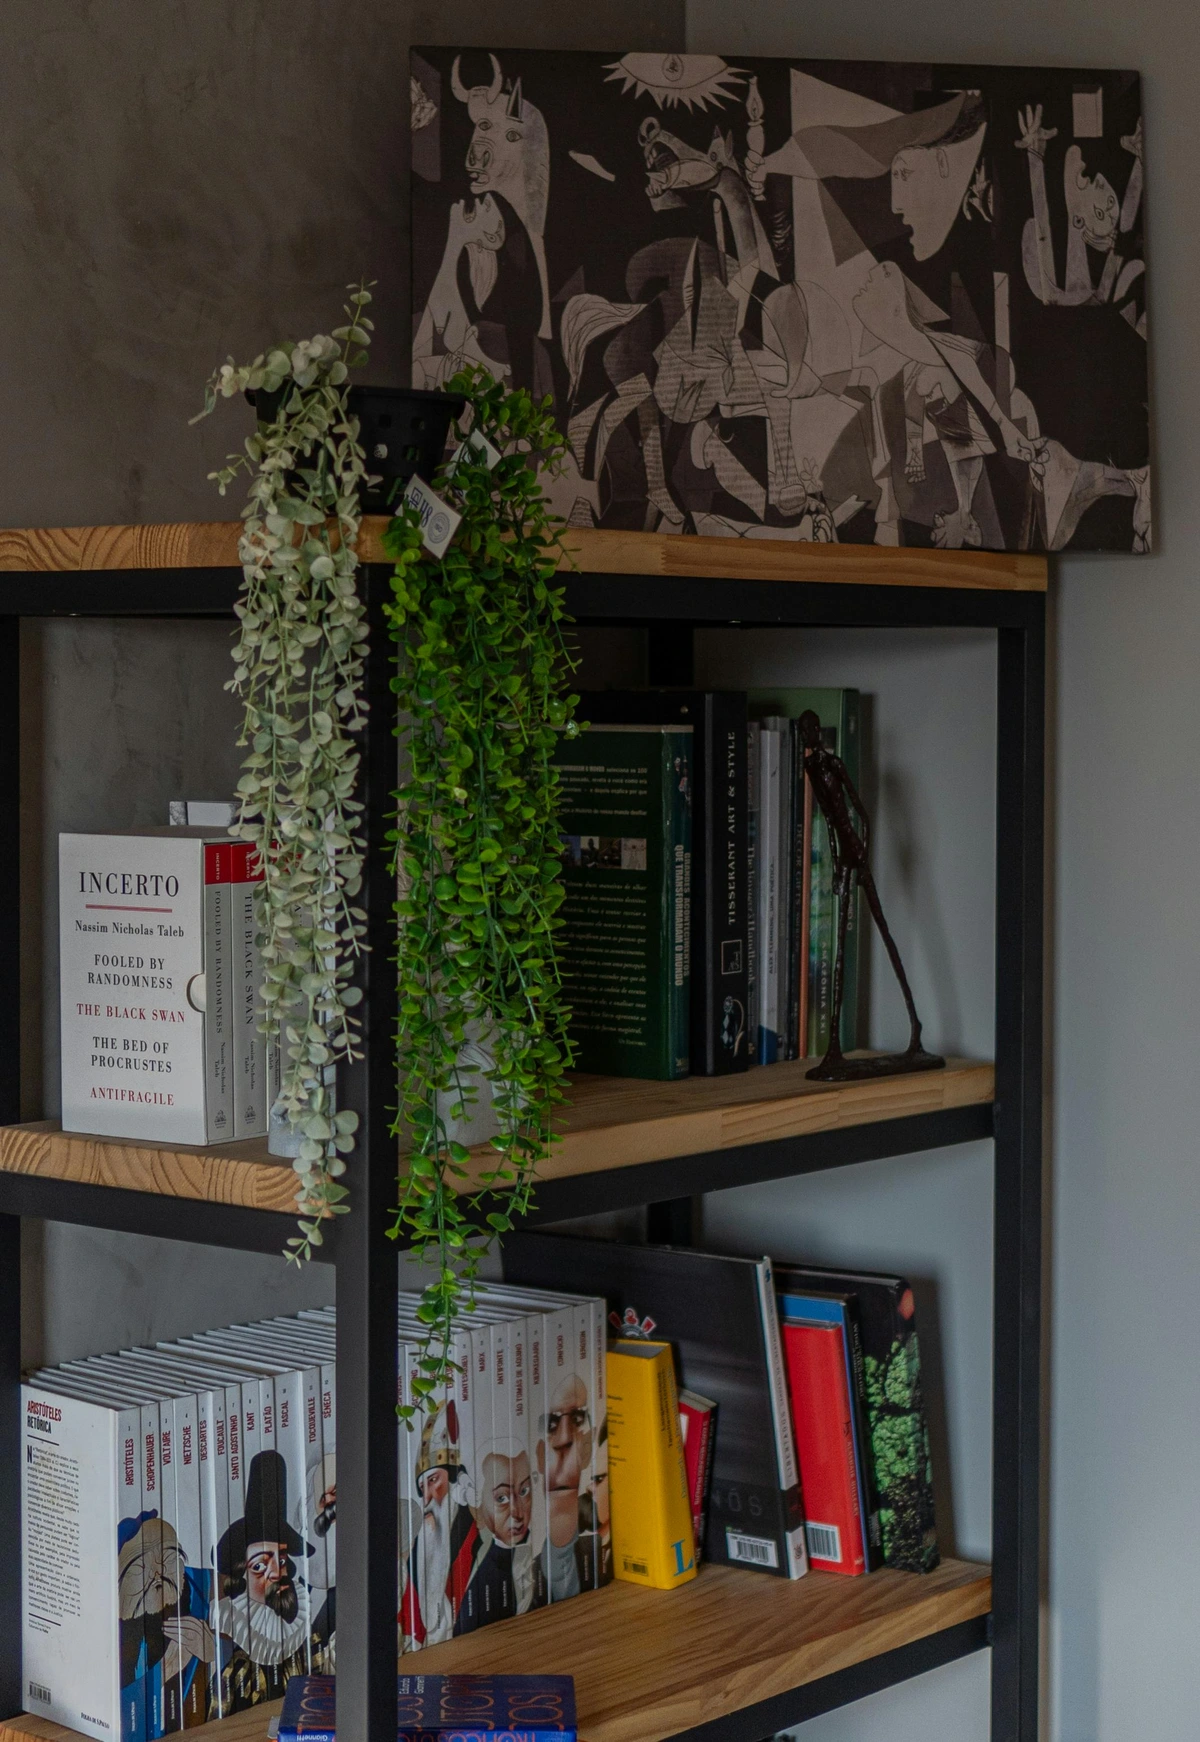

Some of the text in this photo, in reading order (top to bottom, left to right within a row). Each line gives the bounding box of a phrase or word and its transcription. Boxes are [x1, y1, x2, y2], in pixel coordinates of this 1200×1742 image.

[728, 731, 736, 926] TISSERANT ART & STYLE
[674, 844, 684, 862] QUE
[79, 871, 179, 897] INCERTO
[674, 864, 684, 943] TRANSFORMARAM
[75, 920, 185, 938] Nassim Nicholas Taleb
[215, 940, 222, 953] BY
[244, 894, 254, 1025] THE BLACK SWAN
[94, 954, 165, 970] FOOLED BY
[674, 953, 684, 986] MUNDO
[87, 972, 173, 990] RANDOMNESS
[76, 1003, 185, 1022] THE BLACK SWAN
[92, 1036, 170, 1054] THE BED OF
[91, 1054, 172, 1074] PROCRUSTES
[90, 1087, 174, 1106] ANTIFRAGILE
[515, 1368, 522, 1378] DE
[27, 1400, 62, 1422] ARISTÓTELES
[27, 1415, 52, 1434] RETÓRICA
[246, 1412, 255, 1432] KANT
[262, 1406, 272, 1434] PLATÃO
[281, 1400, 289, 1428] PASCAL
[308, 1396, 316, 1444] TOCQUEVILLE
[162, 1430, 171, 1466] VOLTAIRE
[182, 1425, 192, 1466] NIETZSCHE
[200, 1420, 208, 1461] DESCARTES
[217, 1420, 225, 1456] FOUCAULT
[230, 1414, 240, 1480] SANTO AGOSTINHO
[122, 1438, 134, 1486] ARISTÓTELES
[146, 1434, 156, 1492] SCHOPENHAUER
[672, 1538, 694, 1577] L
[398, 1678, 410, 1694] Eduardo
